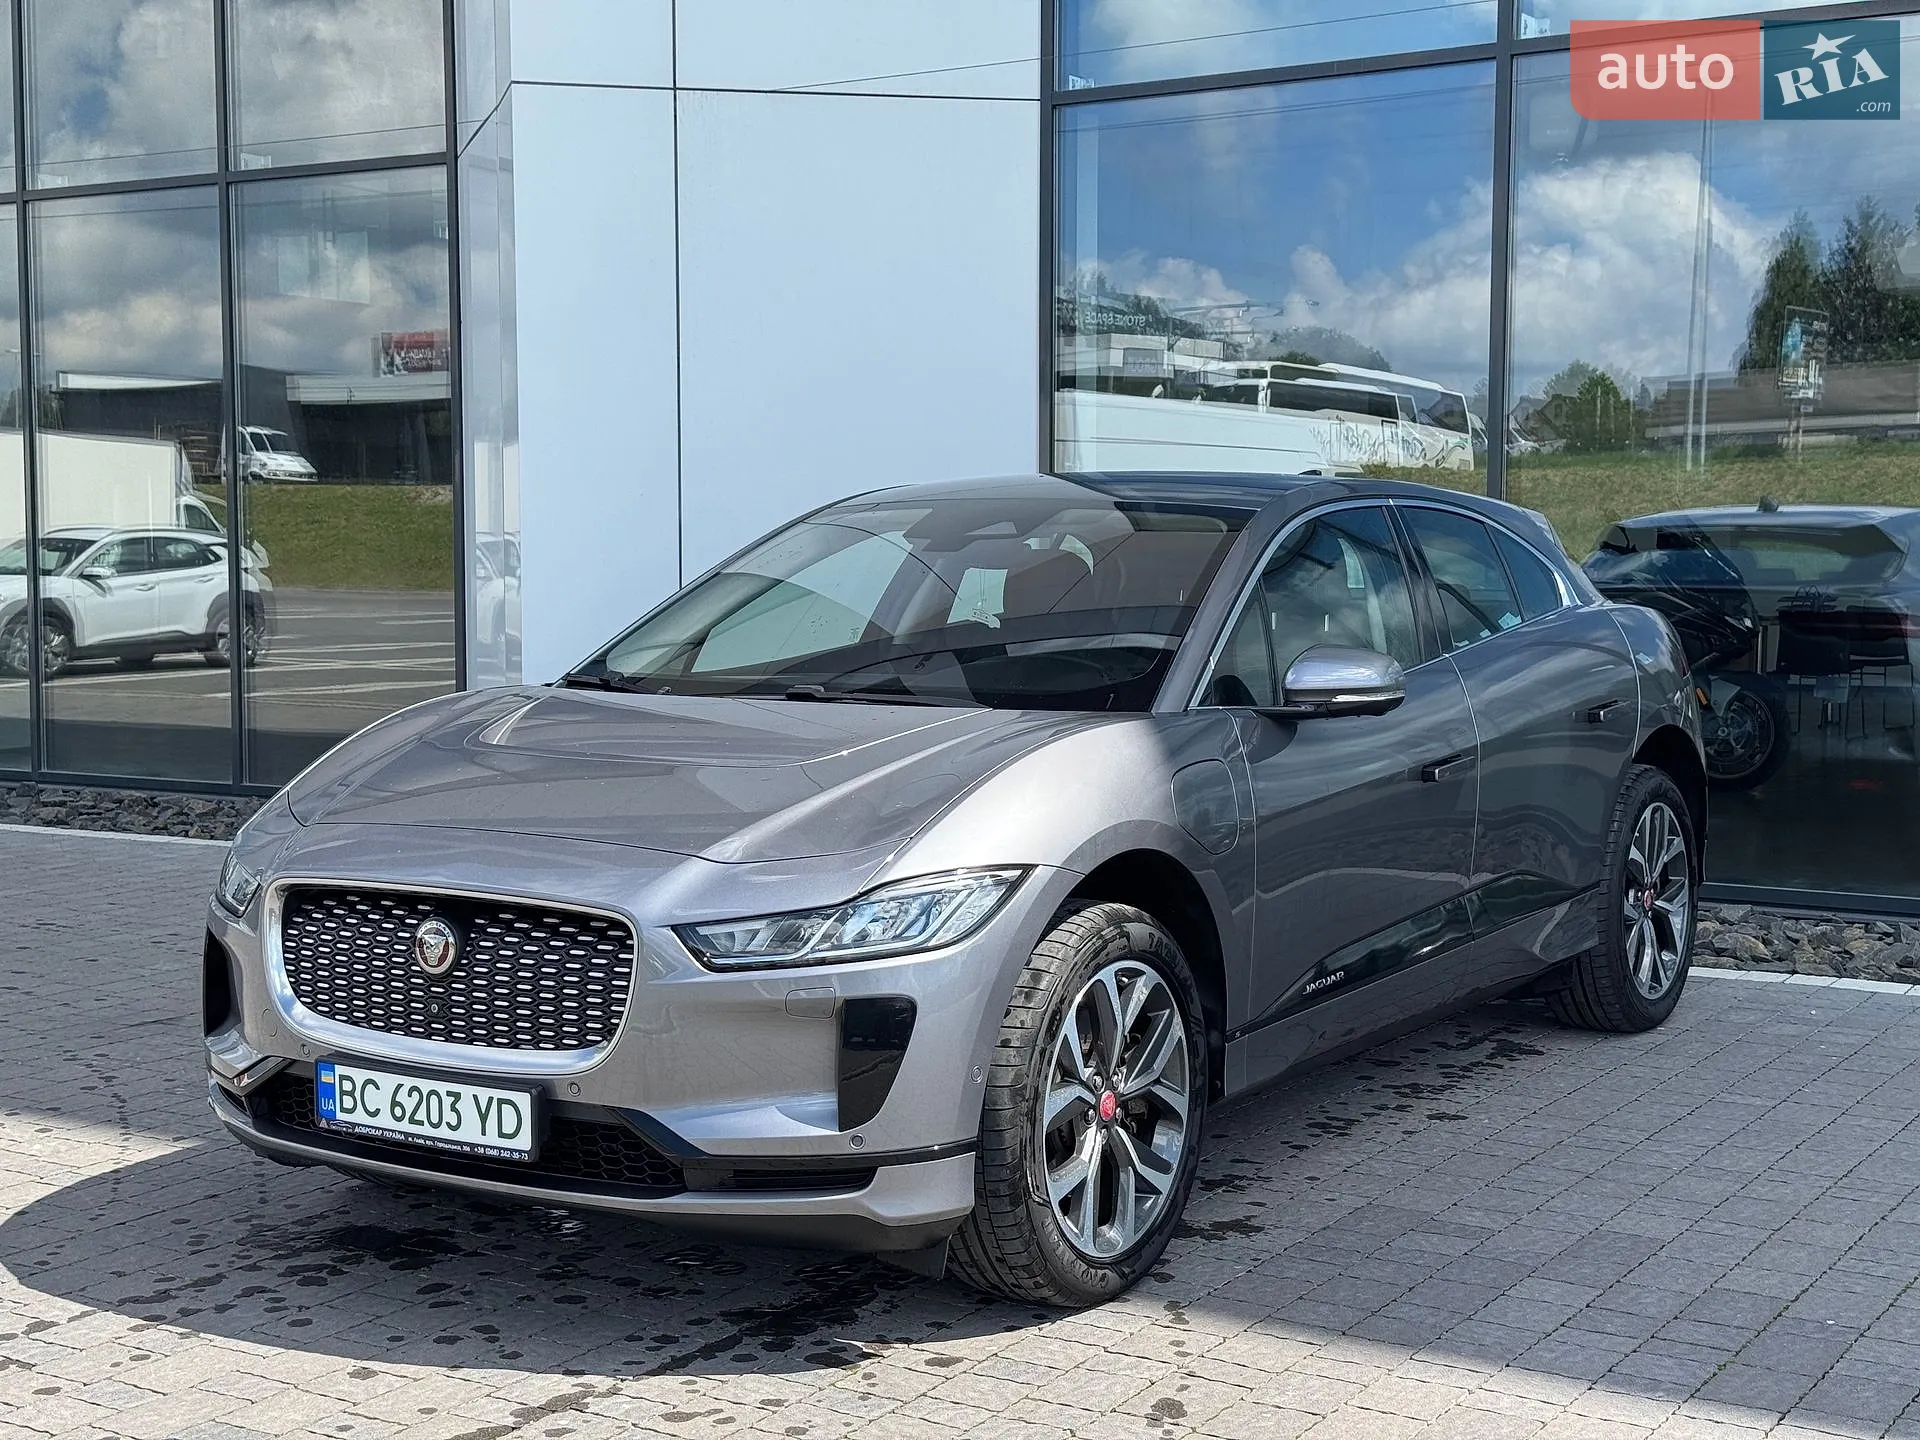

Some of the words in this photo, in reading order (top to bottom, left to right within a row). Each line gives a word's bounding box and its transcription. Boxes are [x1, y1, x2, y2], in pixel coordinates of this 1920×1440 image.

[1302, 971, 1345, 995] JAGUAR
[321, 1097, 336, 1112] UA
[338, 1073, 382, 1118] BC
[389, 1083, 462, 1132] 6203
[472, 1093, 523, 1140] YD
